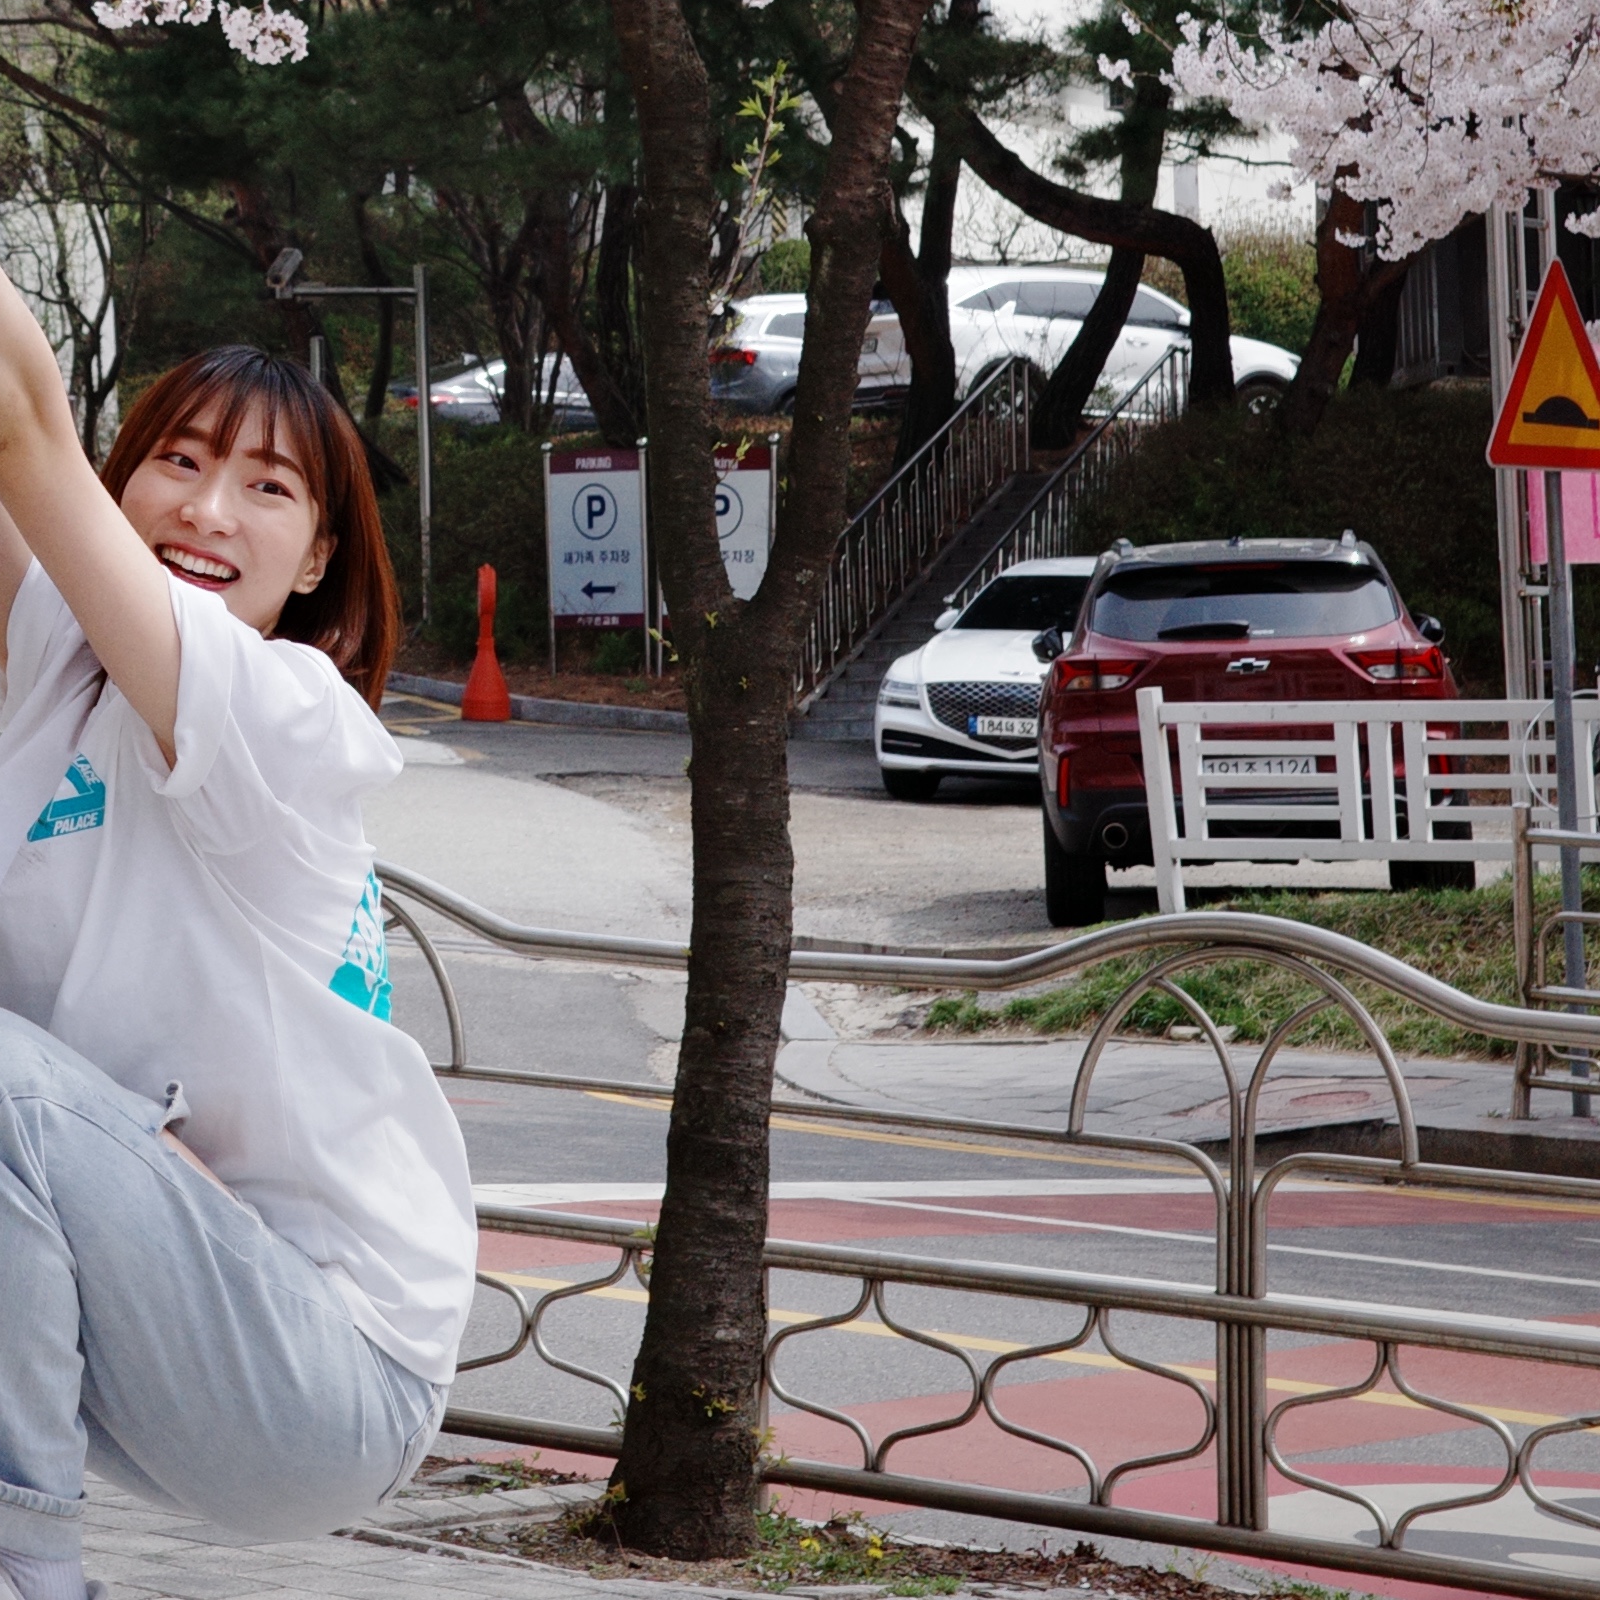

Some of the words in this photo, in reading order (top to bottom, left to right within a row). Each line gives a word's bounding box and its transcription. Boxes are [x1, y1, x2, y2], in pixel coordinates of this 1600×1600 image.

[575, 456, 612, 469] PARKING
[587, 495, 606, 529] P
[600, 549, 630, 563] 주차장
[53, 812, 99, 836] PALACE
